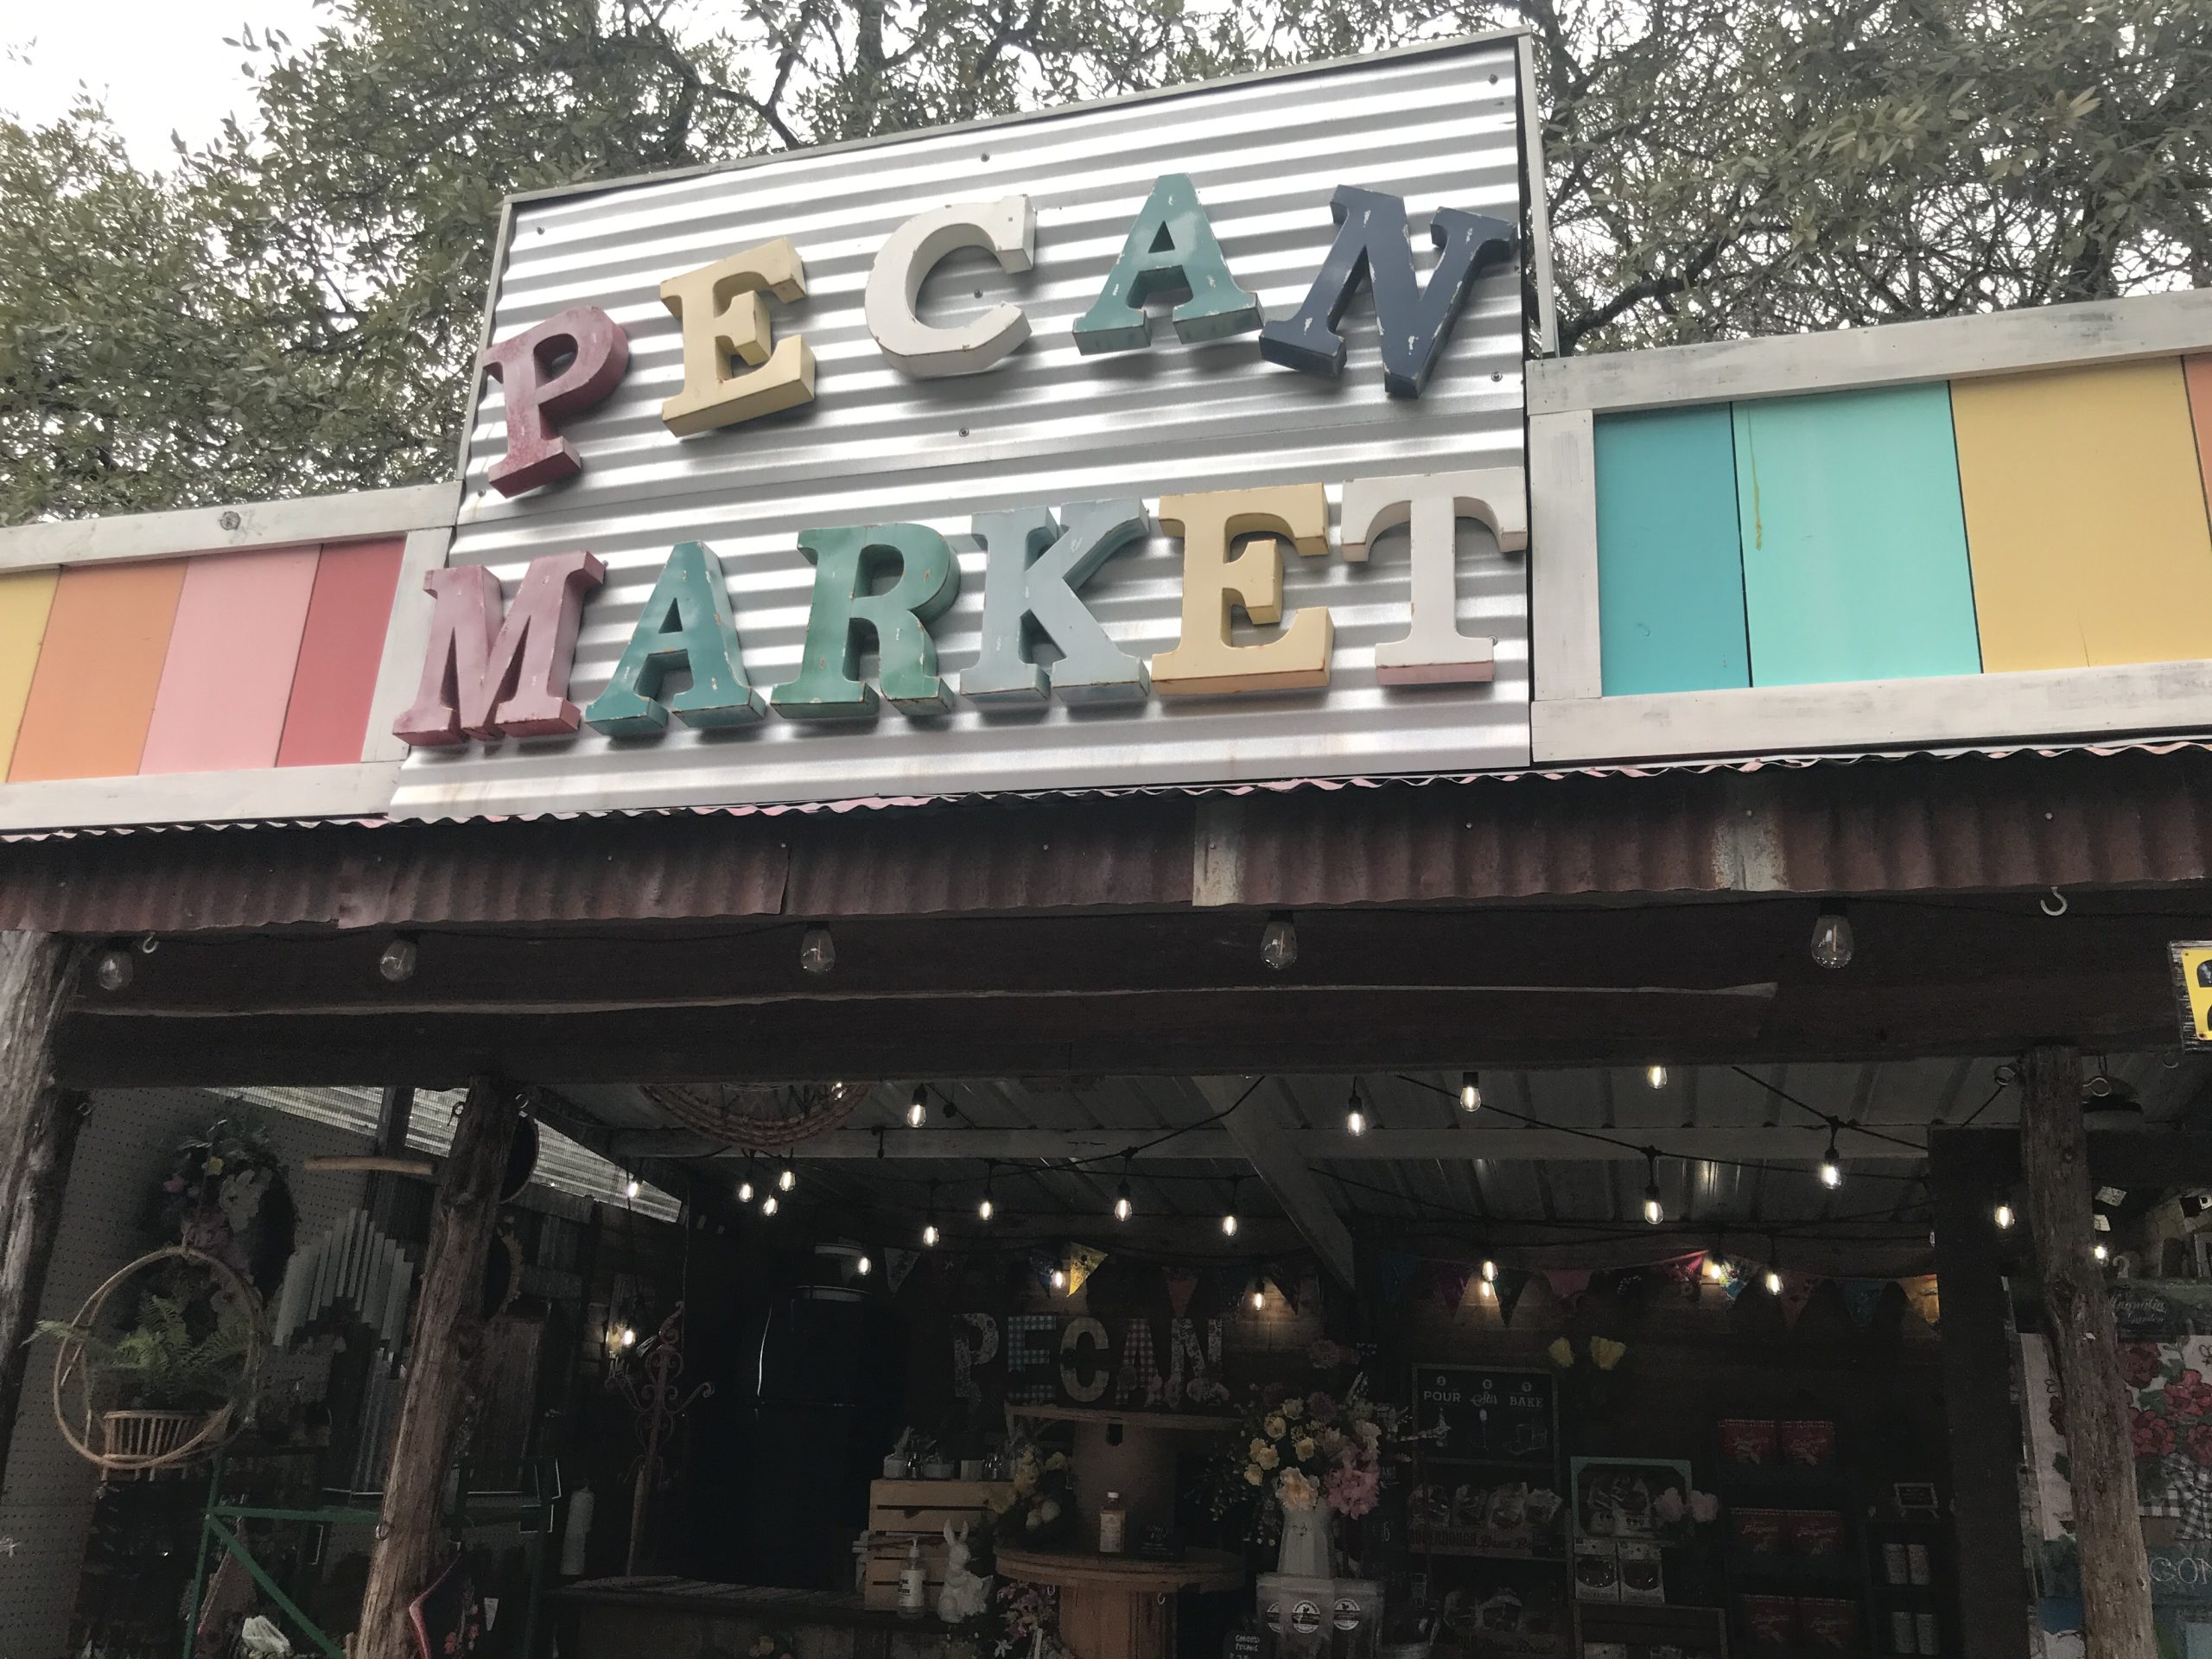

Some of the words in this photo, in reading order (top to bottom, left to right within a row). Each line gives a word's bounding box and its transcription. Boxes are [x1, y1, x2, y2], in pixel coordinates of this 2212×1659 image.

[482, 175, 1518, 498] PECAN
[394, 471, 1529, 747] MARKET
[952, 1313, 1224, 1407] PECAN
[1424, 1390, 1461, 1402] POUR
[1510, 1396, 1543, 1408] BAKE
